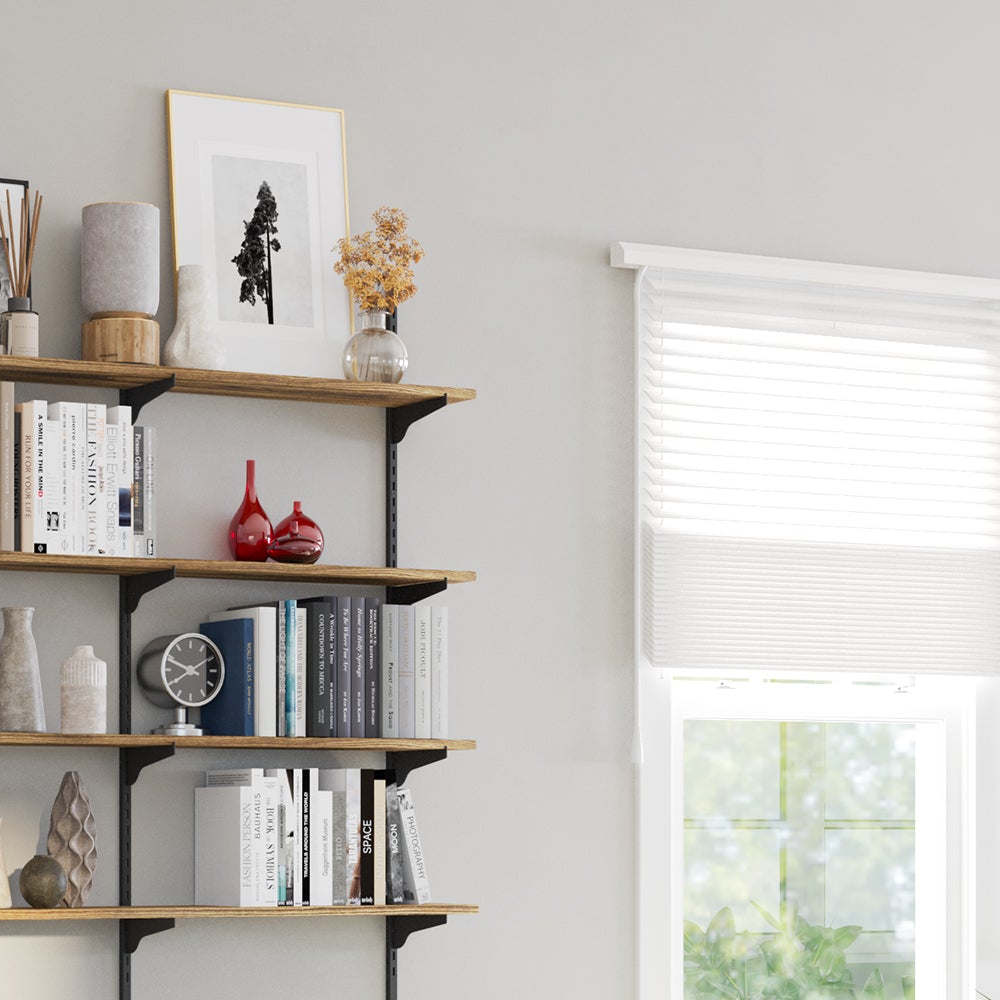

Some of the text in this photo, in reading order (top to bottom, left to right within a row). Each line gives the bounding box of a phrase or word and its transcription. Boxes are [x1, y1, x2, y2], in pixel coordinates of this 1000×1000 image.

[38, 448, 43, 456] IN
[88, 405, 96, 552] THE FASHION BOOK
[105, 427, 118, 541] Elliott Erwitt Snaps
[318, 661, 325, 670] TO
[266, 808, 274, 834] BOOK
[363, 820, 372, 854] SPACE
[390, 824, 399, 853] MOON
[242, 803, 252, 888] FASHION PERSON
[407, 816, 426, 880] PHOTOGRAPHY
[266, 844, 274, 890] SYMBOLS
